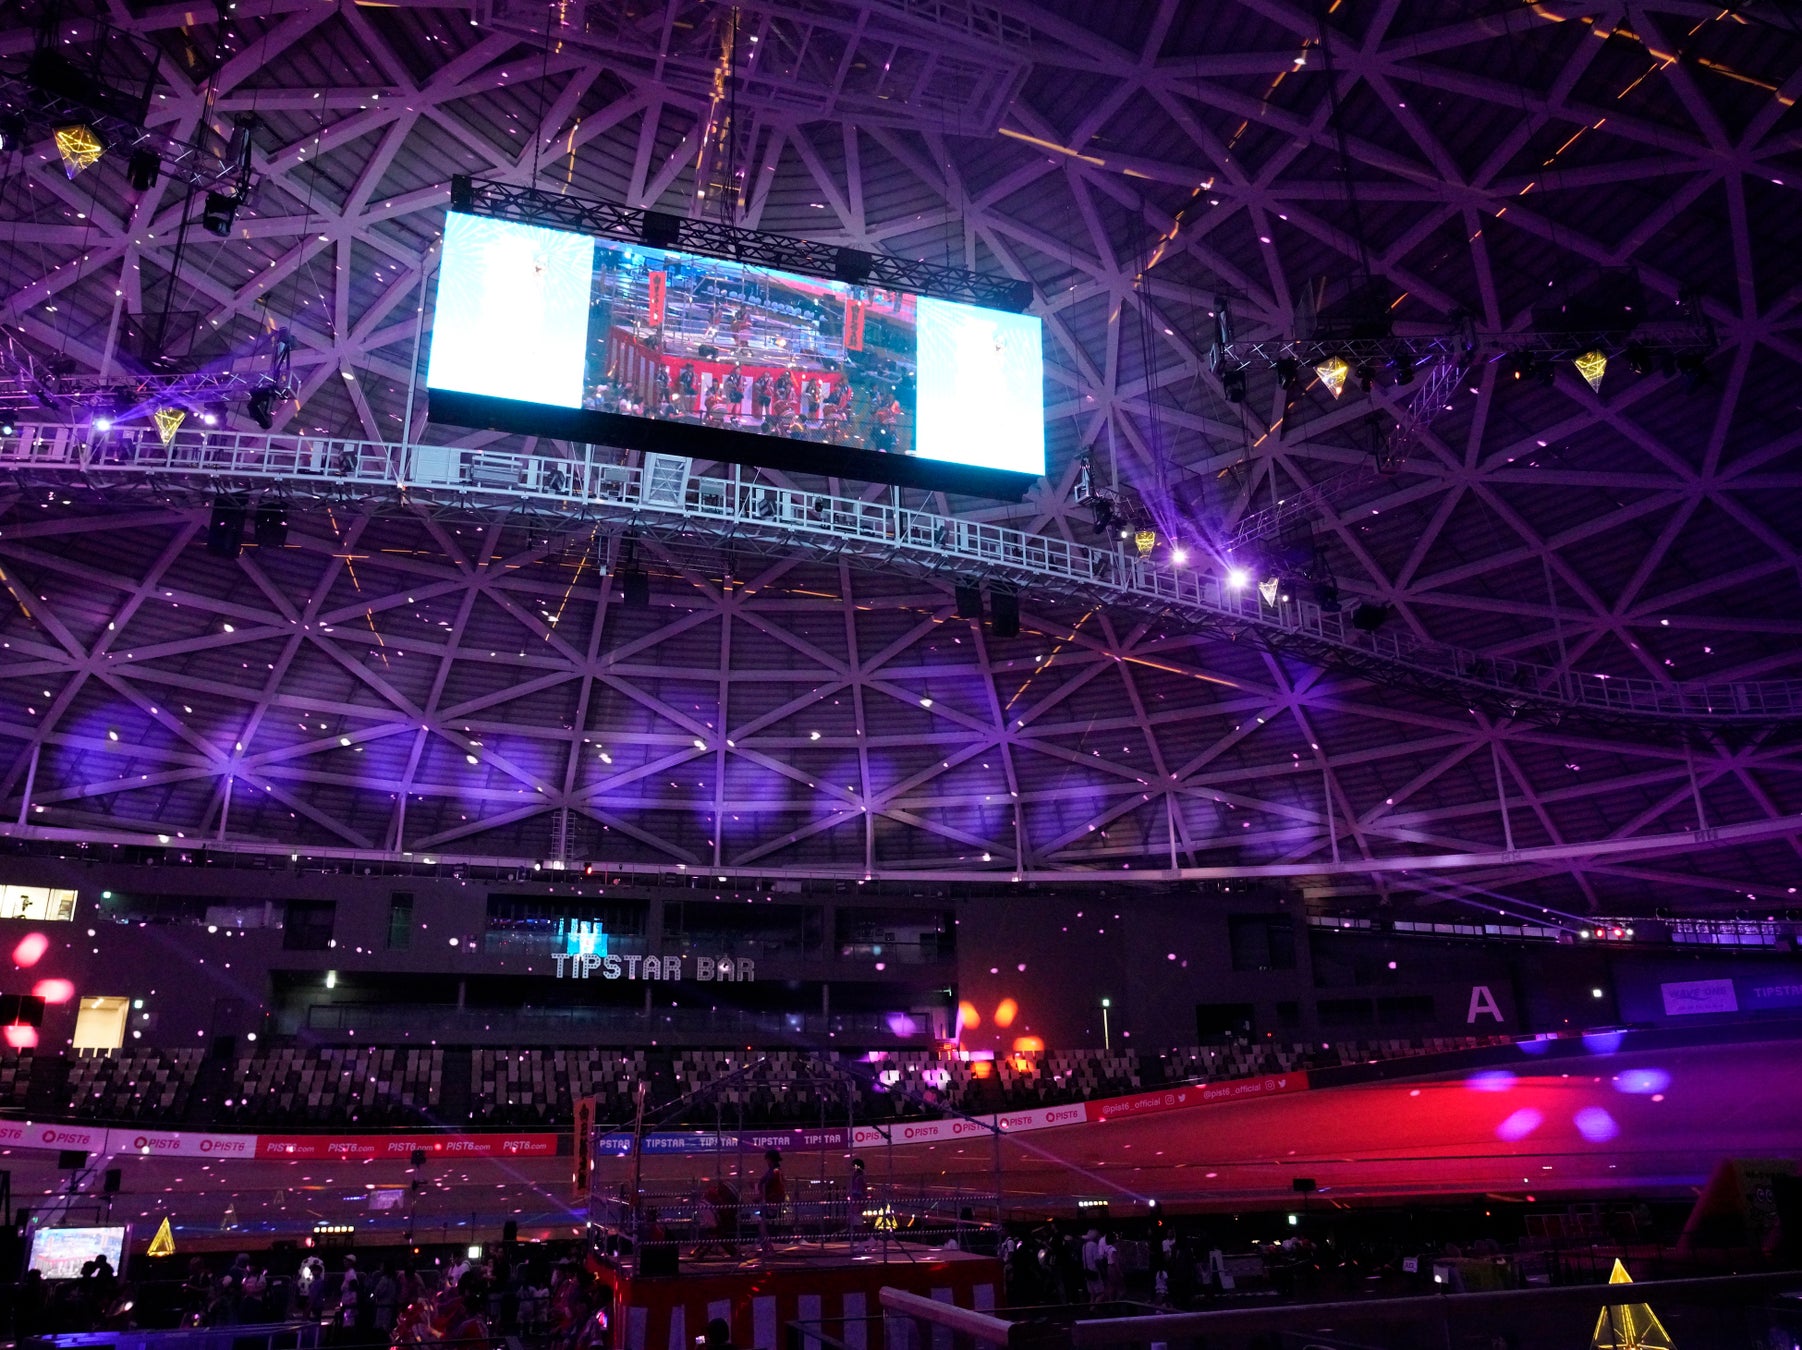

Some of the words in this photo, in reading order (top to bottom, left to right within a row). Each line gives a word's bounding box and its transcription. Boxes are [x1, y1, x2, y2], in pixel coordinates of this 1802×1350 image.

[551, 953, 681, 980] TIPSTAR
[697, 956, 754, 982] BAR
[1753, 985, 1802, 998] TIPSTA
[1466, 985, 1504, 1023] A
[1103, 1097, 1161, 1114] @pist6_official
[1203, 1084, 1261, 1100] @pist6_official
[914, 1126, 939, 1137] PIST6
[1010, 1116, 1032, 1127] PIST6
[1055, 1110, 1078, 1121] PIST6
[0, 1128, 22, 1139] ST6
[55, 1133, 90, 1145] PIST6
[599, 1139, 631, 1149] PSTAR
[645, 1138, 685, 1148] TIPSTAR
[752, 1135, 790, 1146] TIPSTAR
[148, 1138, 181, 1149] PIST6
[213, 1140, 245, 1151] PIST6
[328, 1142, 375, 1152] PIST6.com
[446, 1141, 491, 1151] PIST6.com
[503, 1140, 547, 1150] PIST6.com
